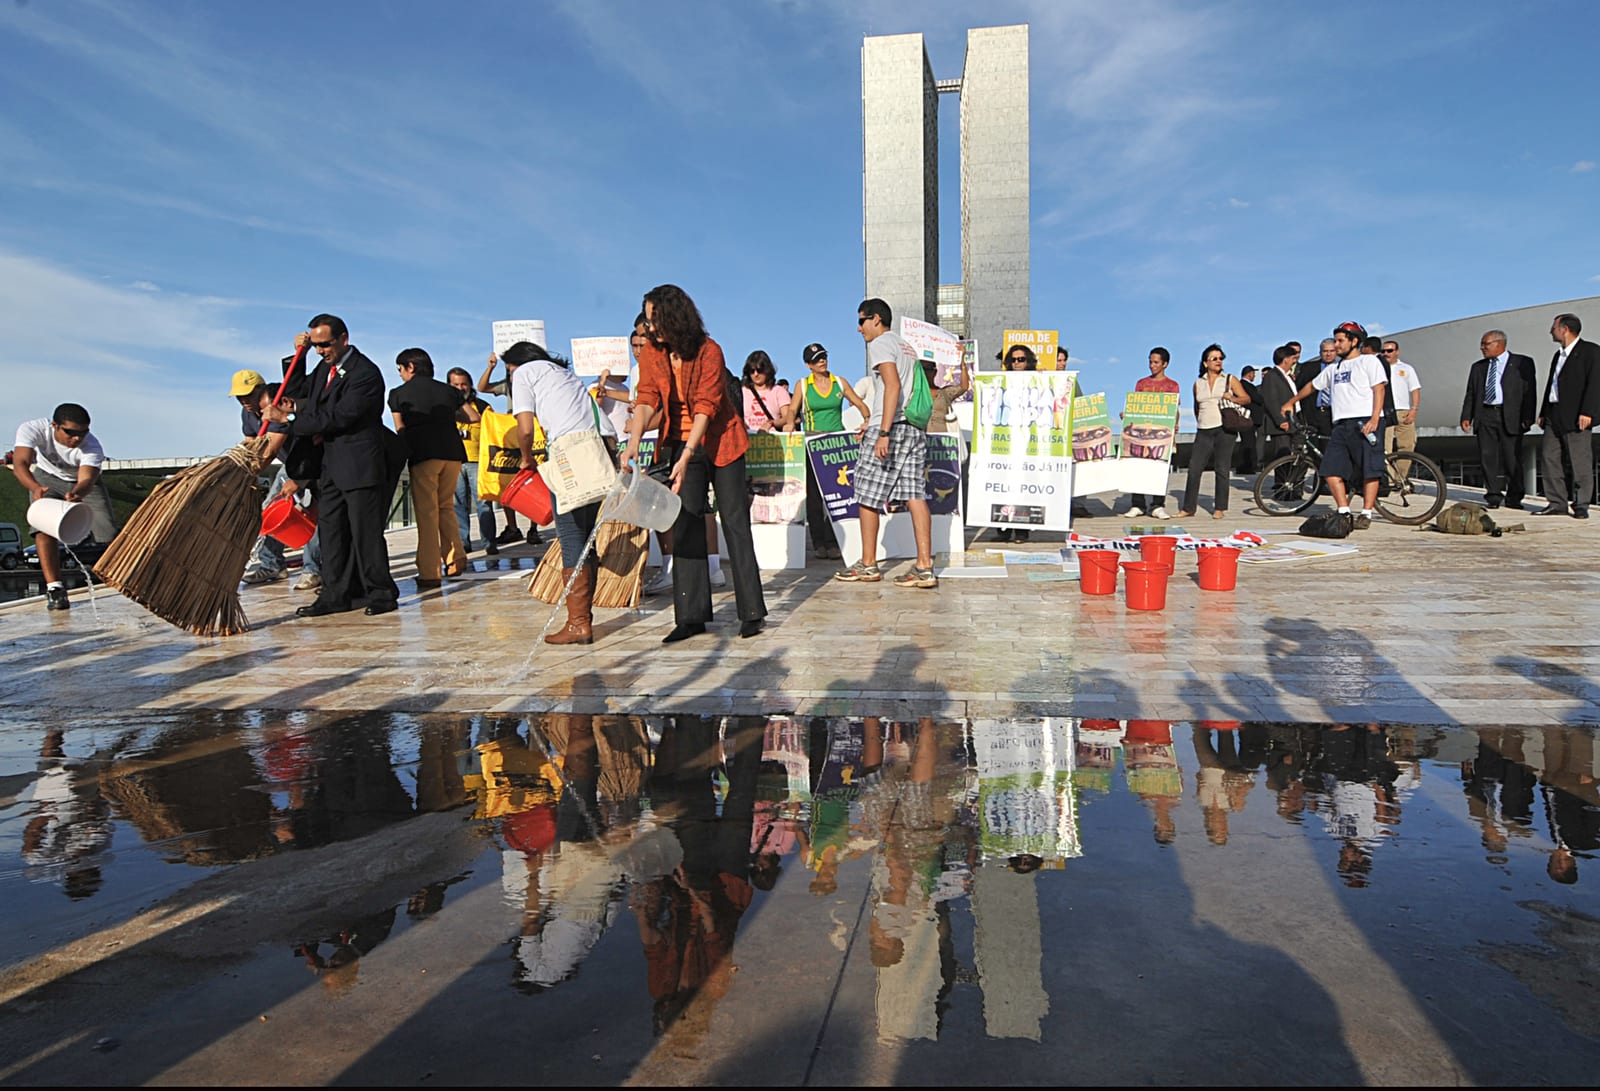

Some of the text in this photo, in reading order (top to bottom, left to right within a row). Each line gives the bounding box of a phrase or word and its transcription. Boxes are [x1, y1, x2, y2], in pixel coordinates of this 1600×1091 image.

[1008, 332, 1051, 343] HORA DE
[1090, 395, 1105, 405] DE
[1127, 393, 1177, 404] CHEGA DE
[1126, 403, 1169, 415] SUJEIRA
[750, 435, 782, 449] HEGA
[809, 436, 848, 453] FAXINA
[822, 448, 860, 466] POLÍTIC
[1020, 484, 1056, 495] POVO
